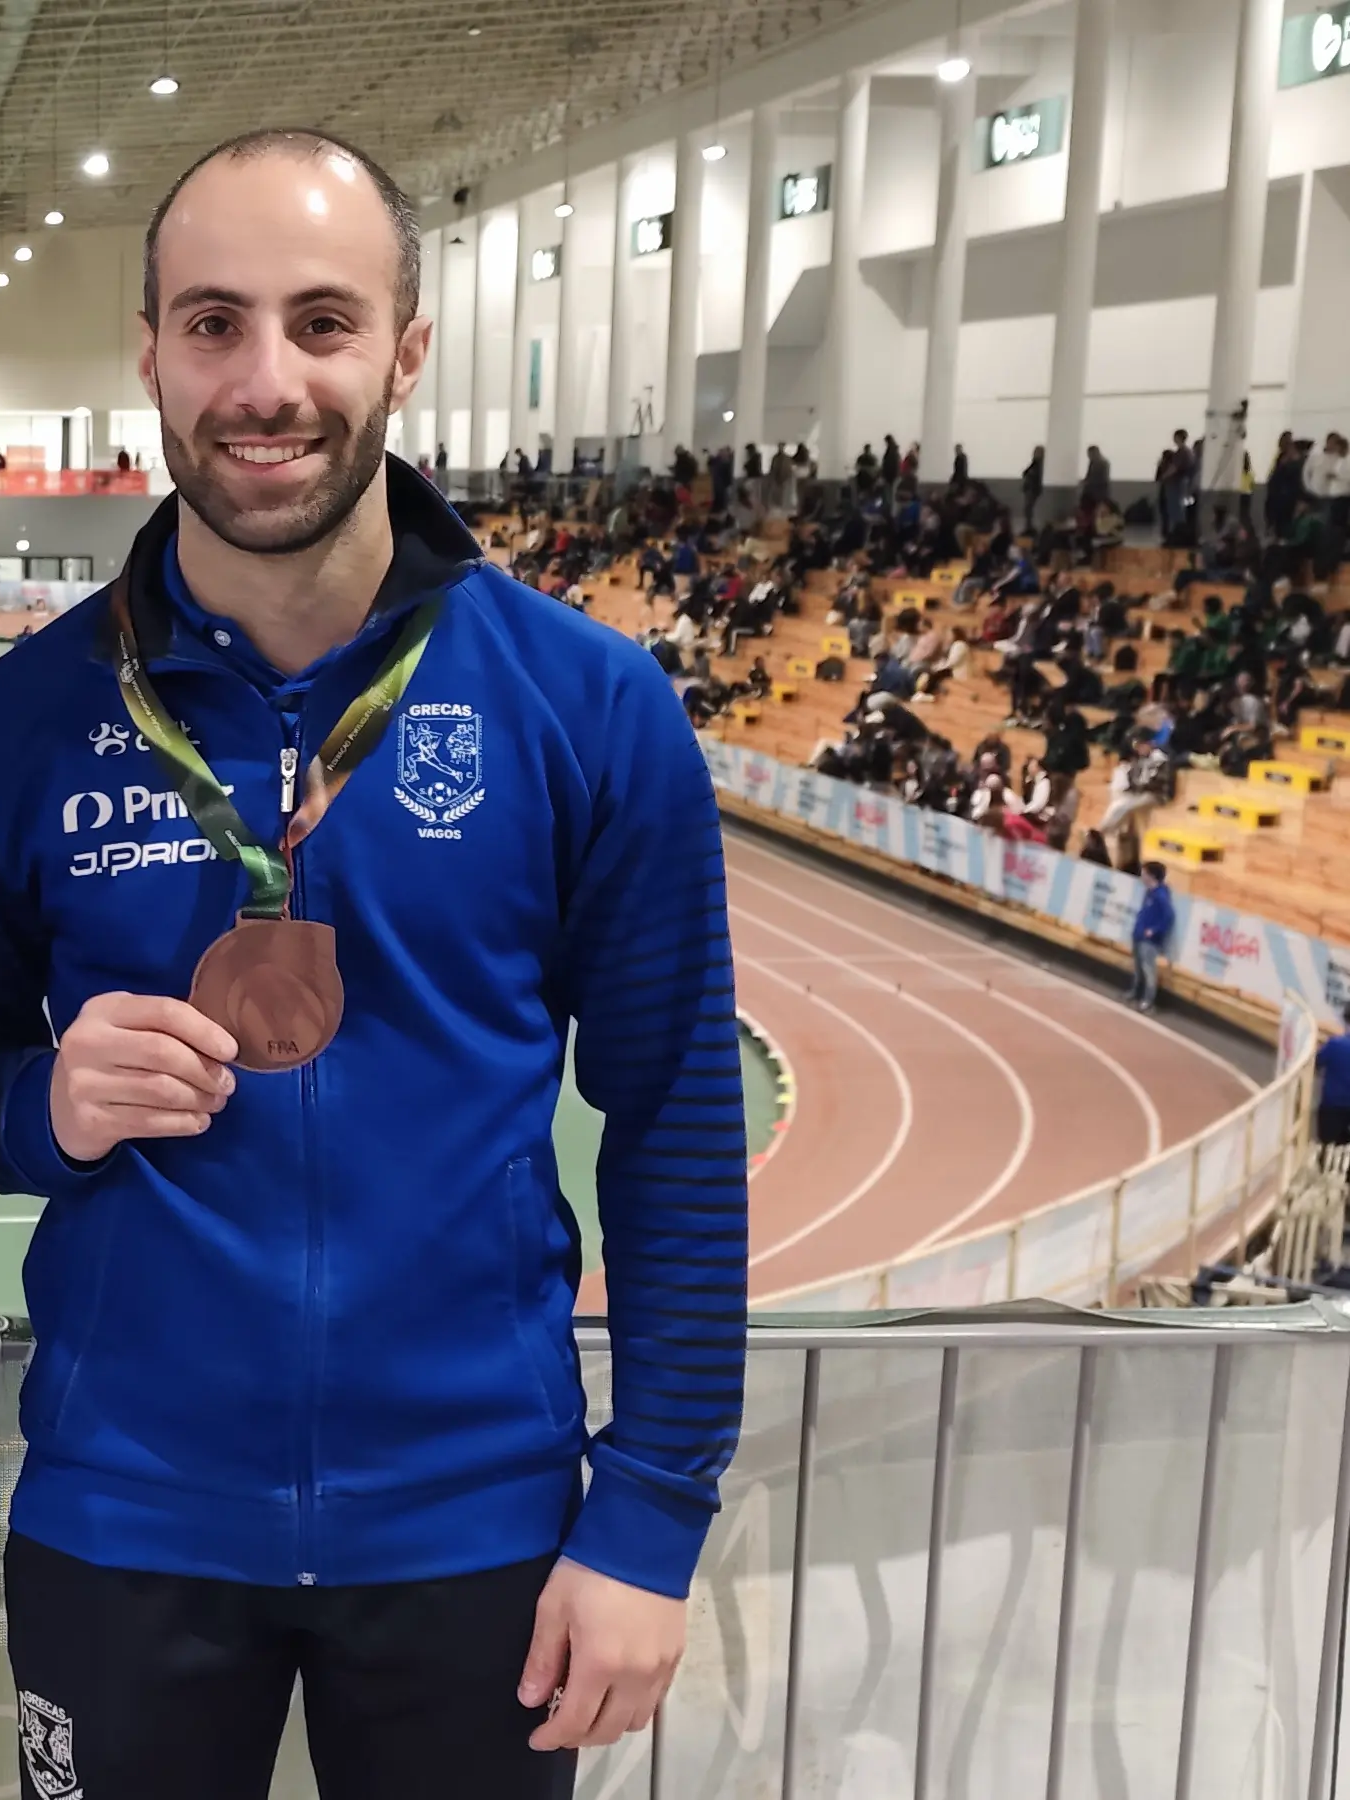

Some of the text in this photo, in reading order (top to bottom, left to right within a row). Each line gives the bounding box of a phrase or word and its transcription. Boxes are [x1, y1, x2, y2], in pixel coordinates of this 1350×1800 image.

[409, 703, 473, 717] GRECAS
[417, 827, 462, 840] VAGOS
[24, 1690, 67, 1720] GRECAS
